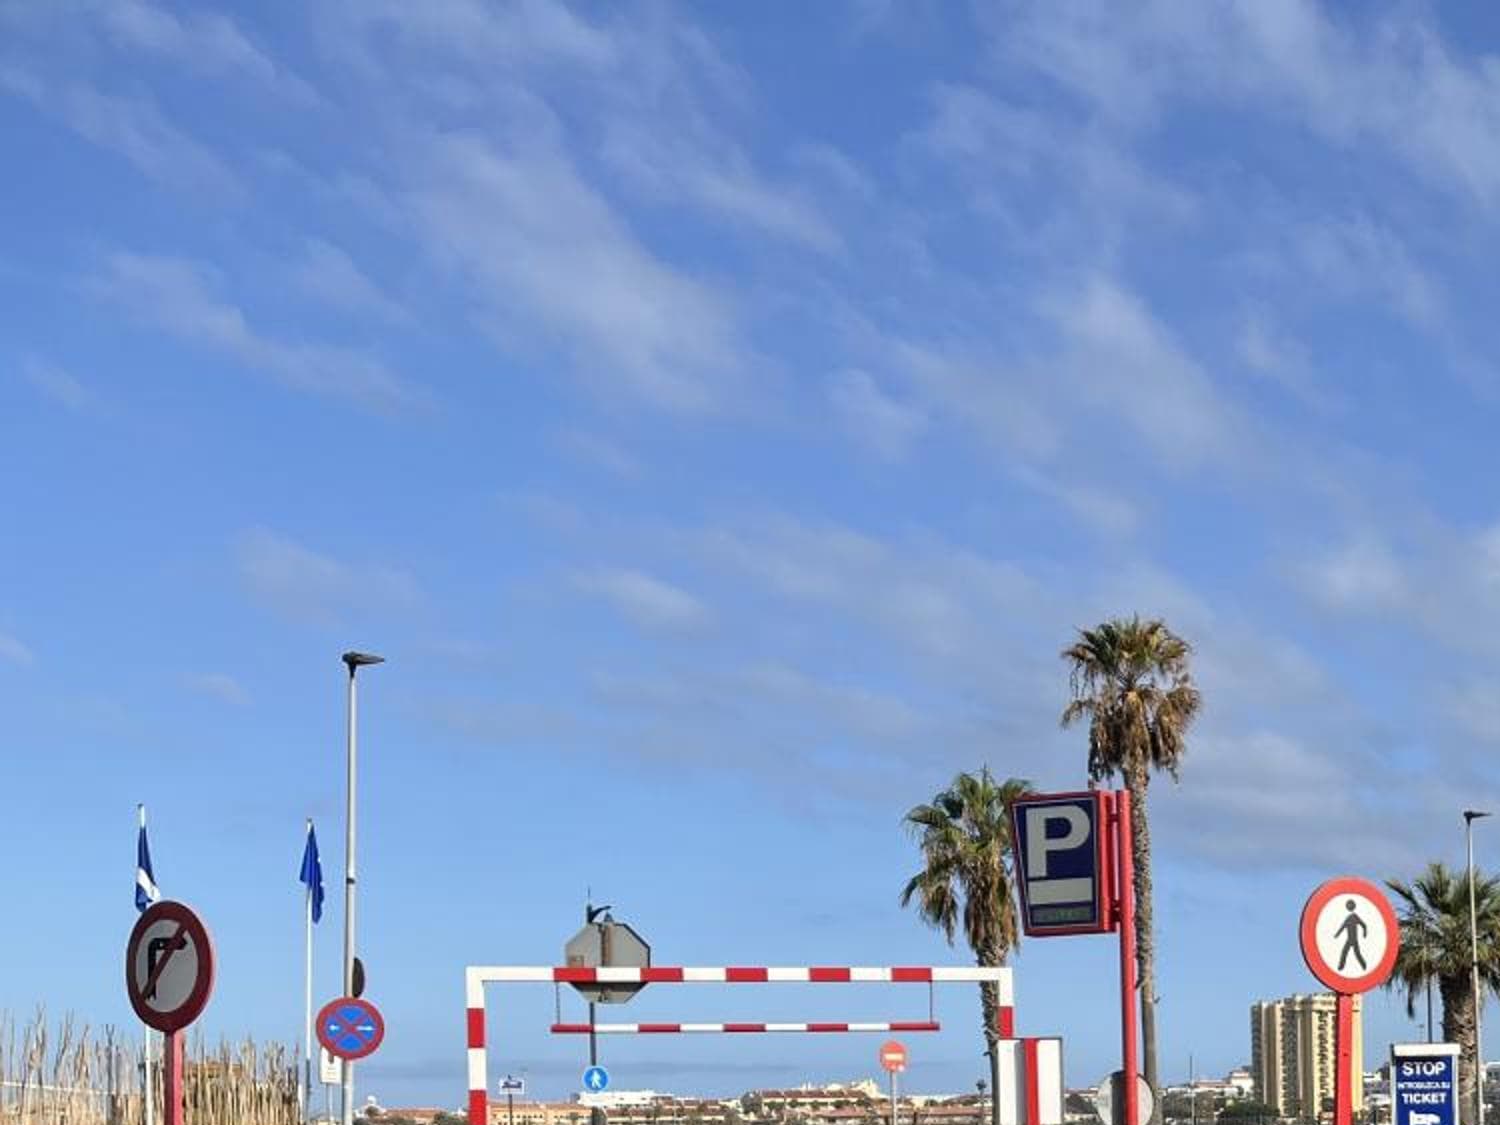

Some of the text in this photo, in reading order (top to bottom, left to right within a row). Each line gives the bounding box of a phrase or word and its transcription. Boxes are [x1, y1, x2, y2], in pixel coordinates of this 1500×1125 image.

[1025, 804, 1091, 878] P
[1402, 1061, 1446, 1077] STOP
[1401, 1092, 1447, 1104] TICKET
